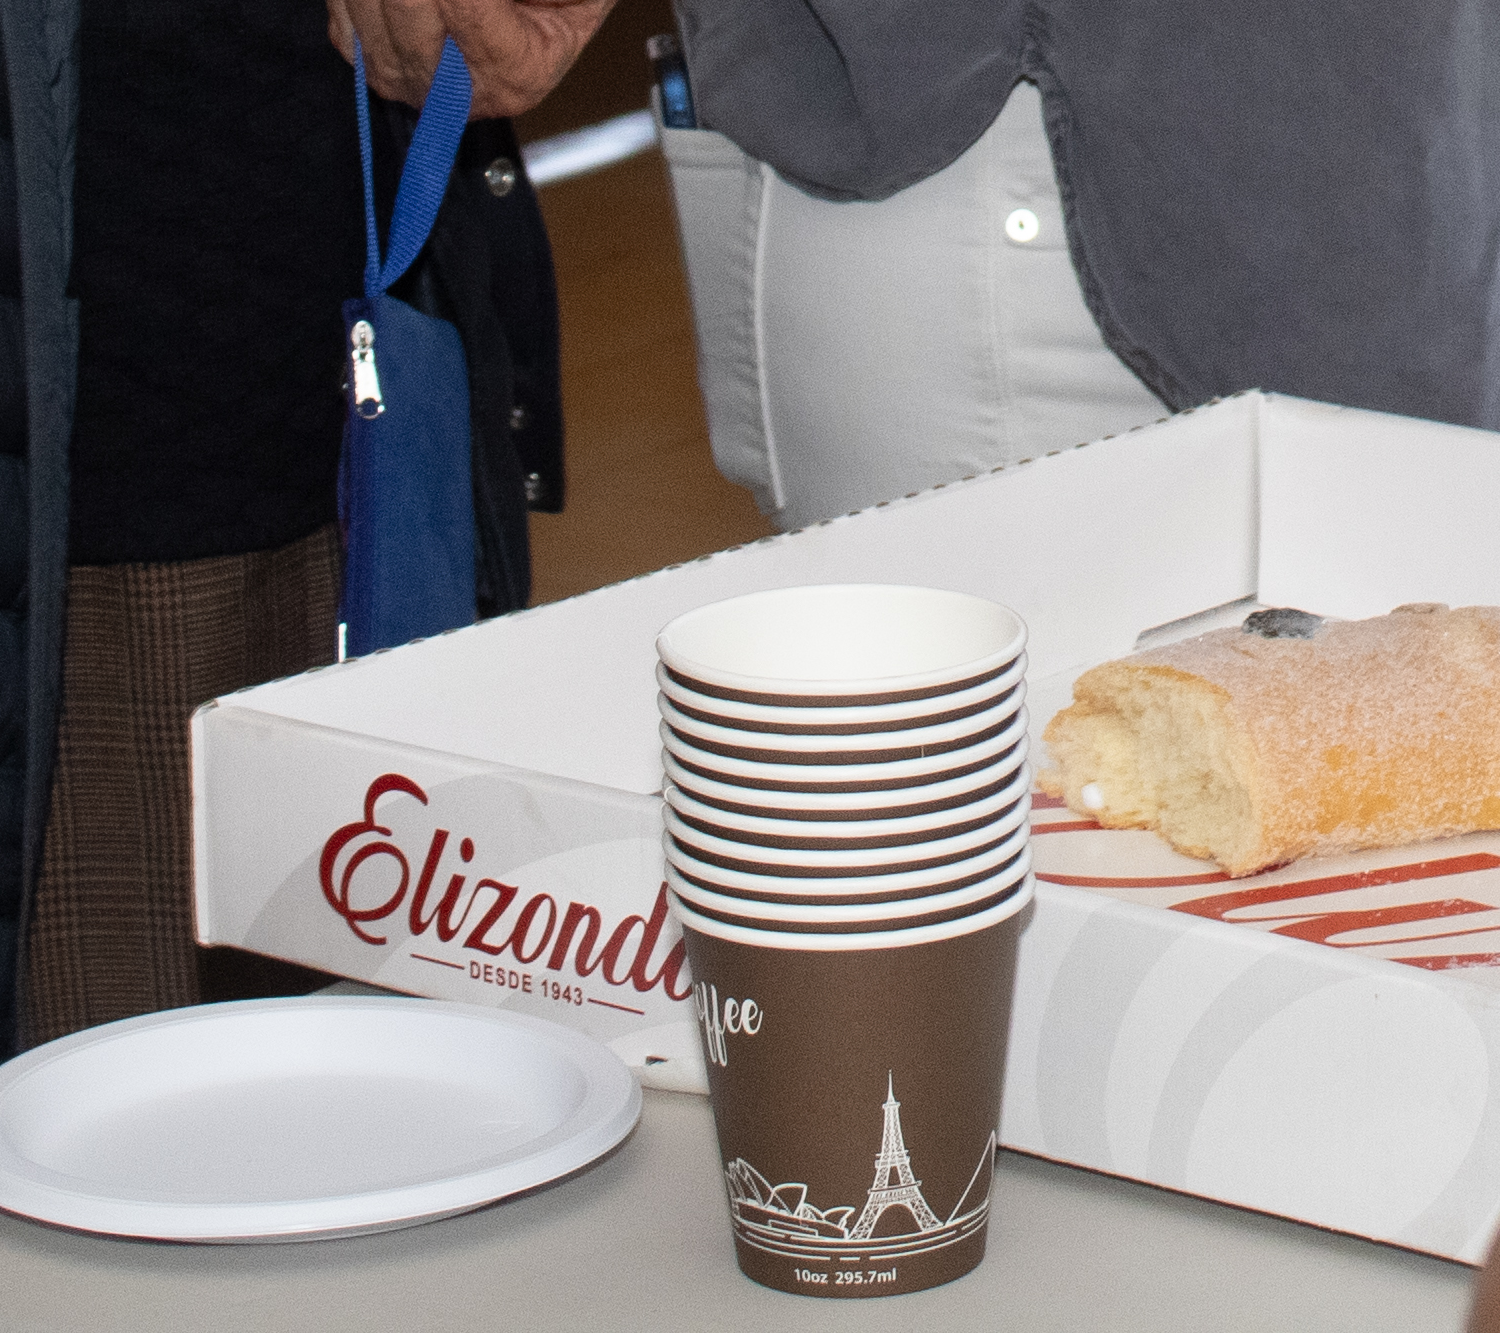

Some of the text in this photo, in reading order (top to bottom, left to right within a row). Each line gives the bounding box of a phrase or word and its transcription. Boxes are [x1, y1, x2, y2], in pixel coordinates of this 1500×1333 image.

[469, 959, 584, 1007] DESDE 1943
[694, 981, 764, 1067] ffee
[793, 1267, 897, 1285] 10oz 295.7ml
